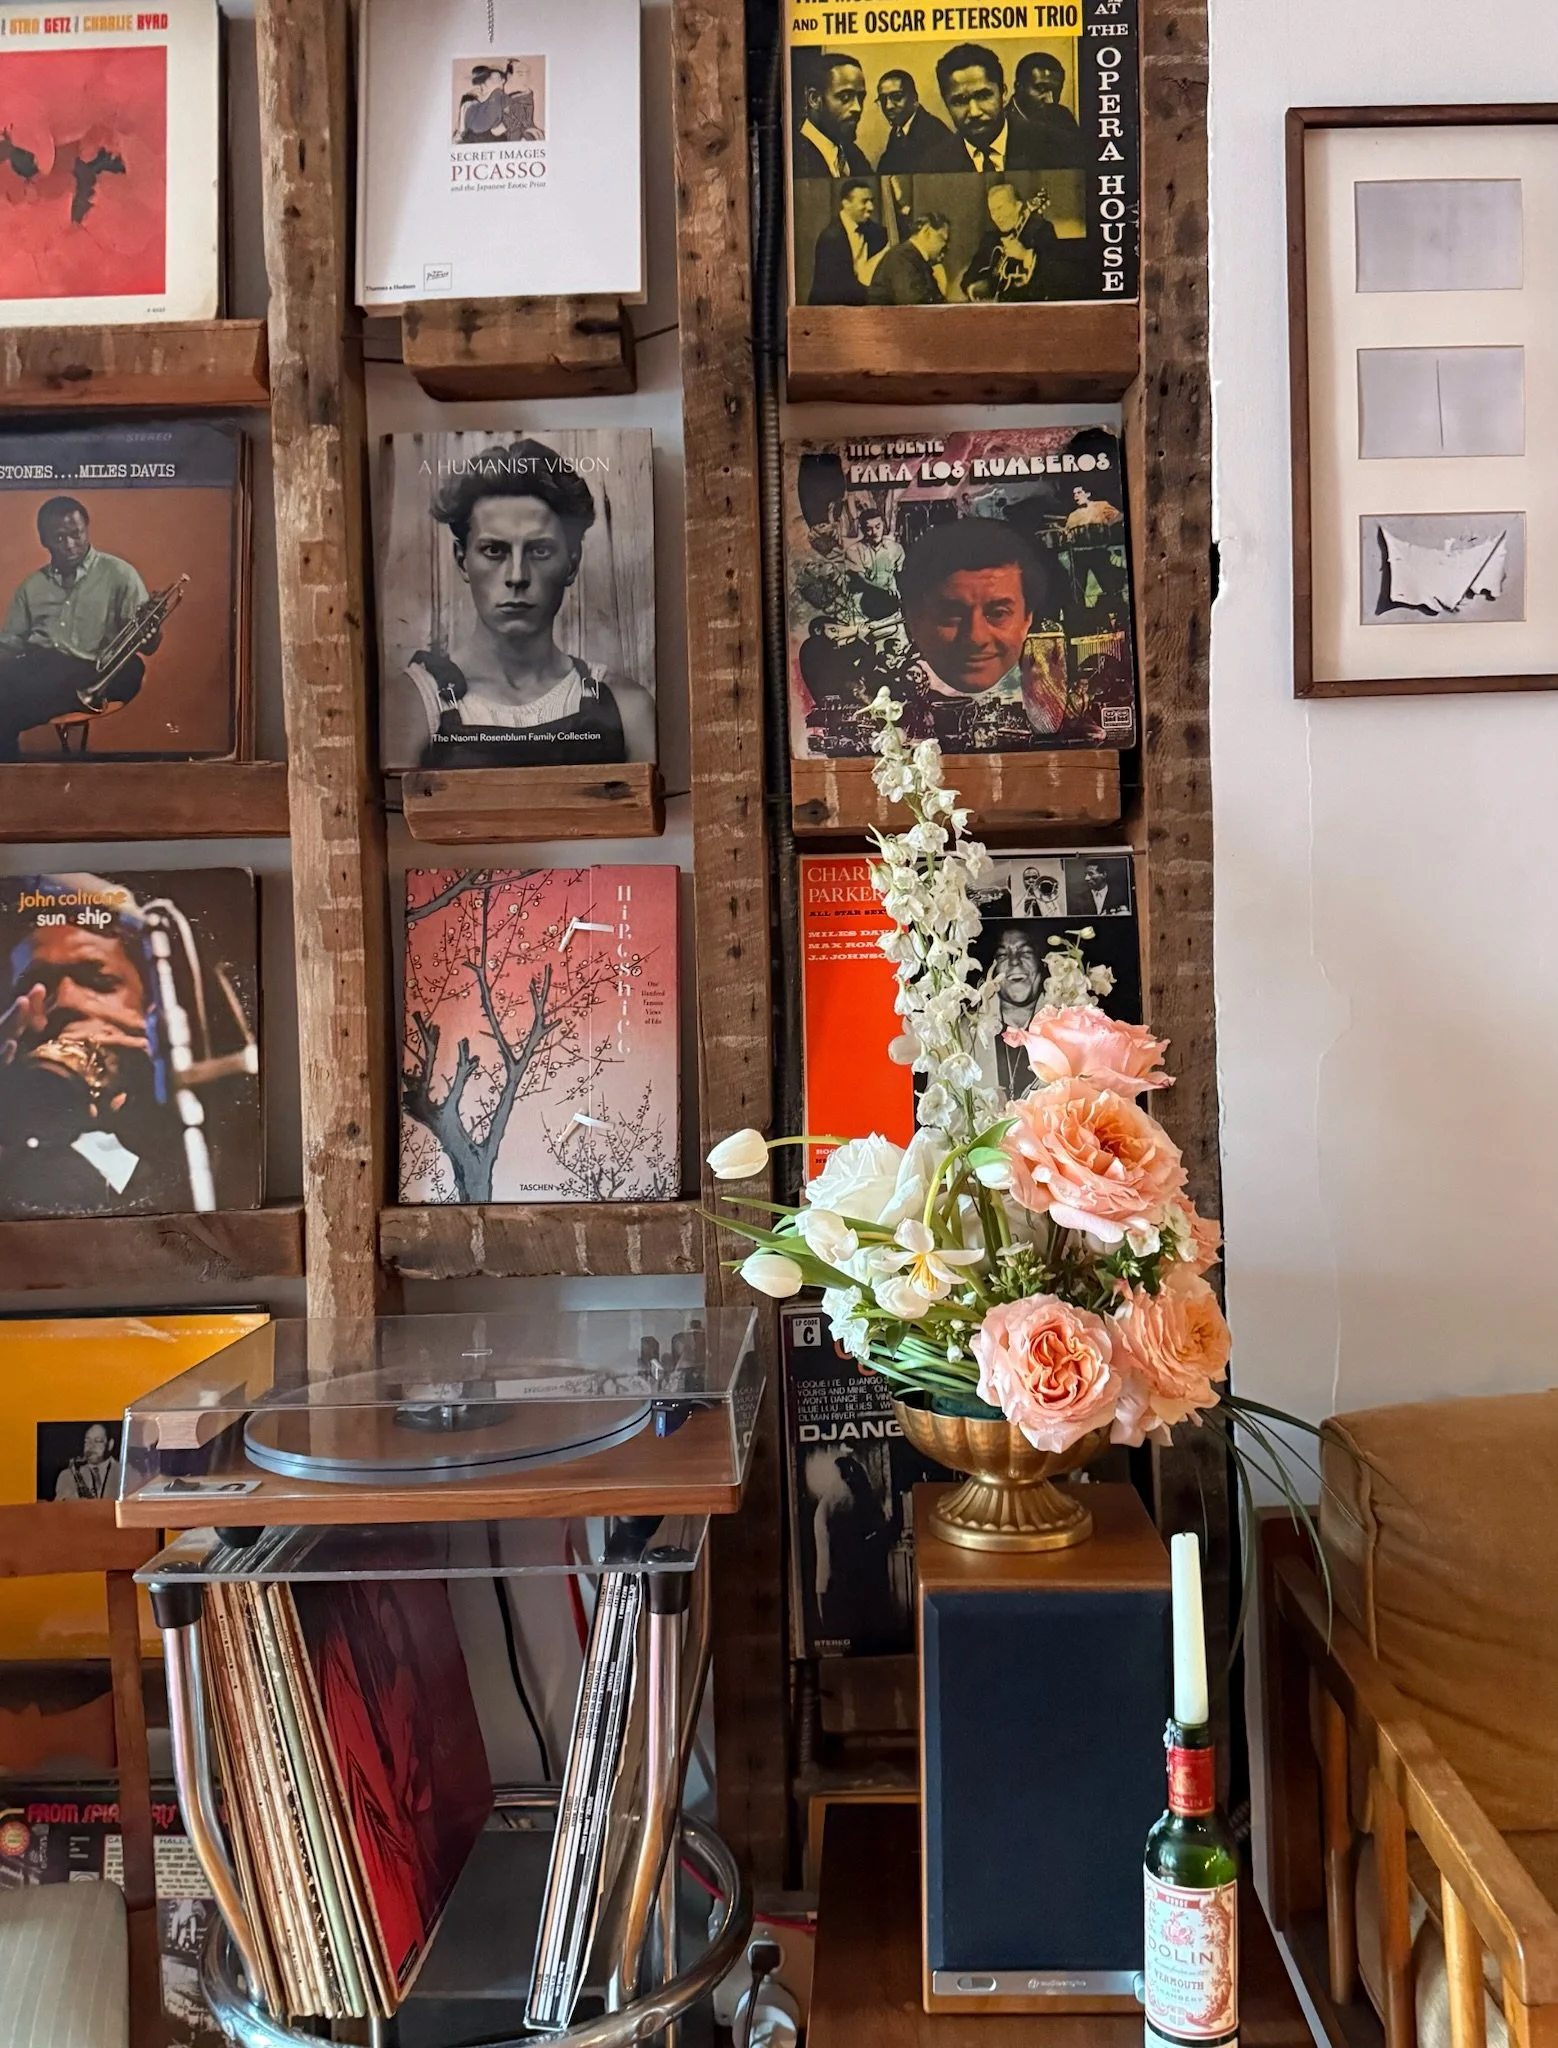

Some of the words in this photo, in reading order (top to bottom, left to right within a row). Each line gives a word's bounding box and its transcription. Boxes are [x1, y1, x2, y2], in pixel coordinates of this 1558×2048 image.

[1094, 2, 1121, 15] AT
[44, 17, 71, 34] GETZ
[83, 14, 133, 32] CHARLIE
[136, 13, 168, 30] BYRD
[792, 19, 818, 32] AND
[822, 12, 858, 35] THE
[864, 10, 925, 34] OSCAR
[932, 6, 1028, 31] PETERSON
[1034, 4, 1078, 28] TRIO
[1087, 24, 1128, 37] THE
[1096, 47, 1124, 162] OPERA
[450, 151, 494, 162] SECRET
[500, 149, 546, 160] IMAGES
[452, 162, 546, 182] PICASSO
[476, 183, 506, 192] Japanese
[1098, 174, 1126, 293] HOUSE
[850, 443, 882, 458] TITO
[886, 440, 944, 456] PUENTE
[130, 464, 176, 478] DAVIS
[418, 460, 432, 474] A
[438, 458, 541, 475] HUMANIST
[544, 456, 610, 474] VISION
[850, 462, 913, 484] PARA
[921, 459, 965, 481] LOS
[972, 452, 1110, 478] RUMBEROS
[432, 734, 449, 743] The
[450, 733, 478, 742] Naomi
[480, 732, 526, 742] Rosenblum
[528, 732, 556, 743] Family
[557, 732, 600, 740] Collection
[18, 889, 55, 913] john
[58, 888, 128, 906] coltrane
[36, 913, 66, 926] sun
[77, 906, 112, 930] ship
[808, 930, 858, 938] MILES
[808, 942, 842, 950] MAX
[803, 1327, 815, 1345] C
[800, 1420, 905, 1442] DJANG
[28, 1804, 78, 1824] FROM
[1154, 1968, 1204, 1991] VERMOUTH
